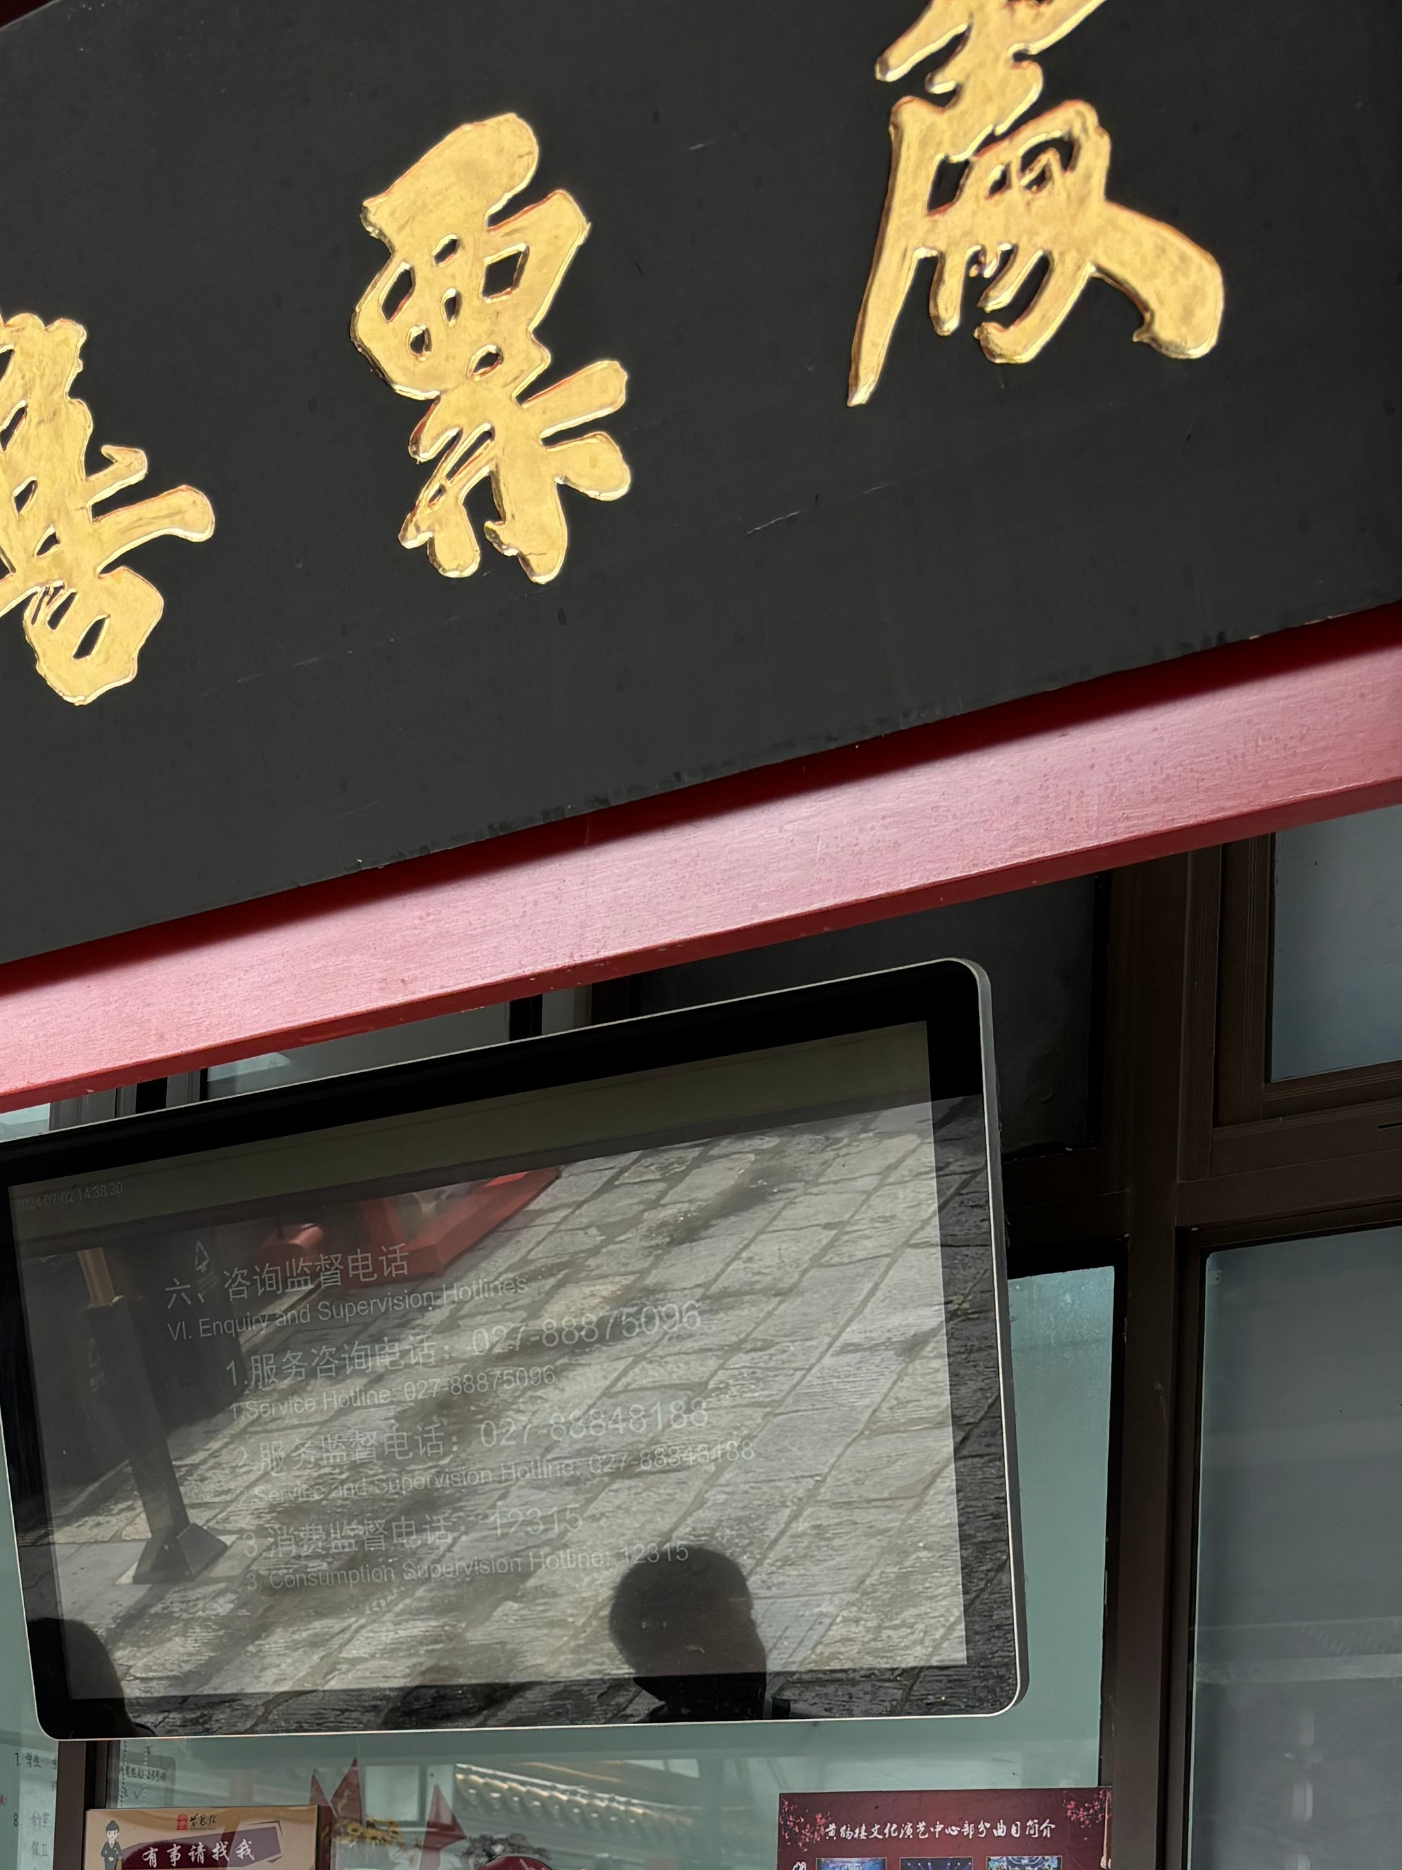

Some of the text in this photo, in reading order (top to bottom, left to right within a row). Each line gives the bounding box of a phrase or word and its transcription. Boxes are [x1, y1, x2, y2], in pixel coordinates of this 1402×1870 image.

[163, 1241, 412, 1311] 六、咨询监督电话
[198, 1308, 273, 1340] Enquiry
[274, 1304, 310, 1327] and
[317, 1286, 436, 1325] Supervision
[441, 1272, 528, 1305] Hotlines
[322, 1382, 394, 1410] Hotline:
[403, 1364, 555, 1400] 027-88875096
[331, 1477, 366, 1498] and
[374, 1464, 493, 1497] Supervision
[269, 1562, 395, 1592] Consumption
[402, 1553, 521, 1584] Supervision
[529, 1546, 610, 1571] Hotline:
[618, 1541, 689, 1565] 12315
[142, 1838, 255, 1868] 有事请找我
